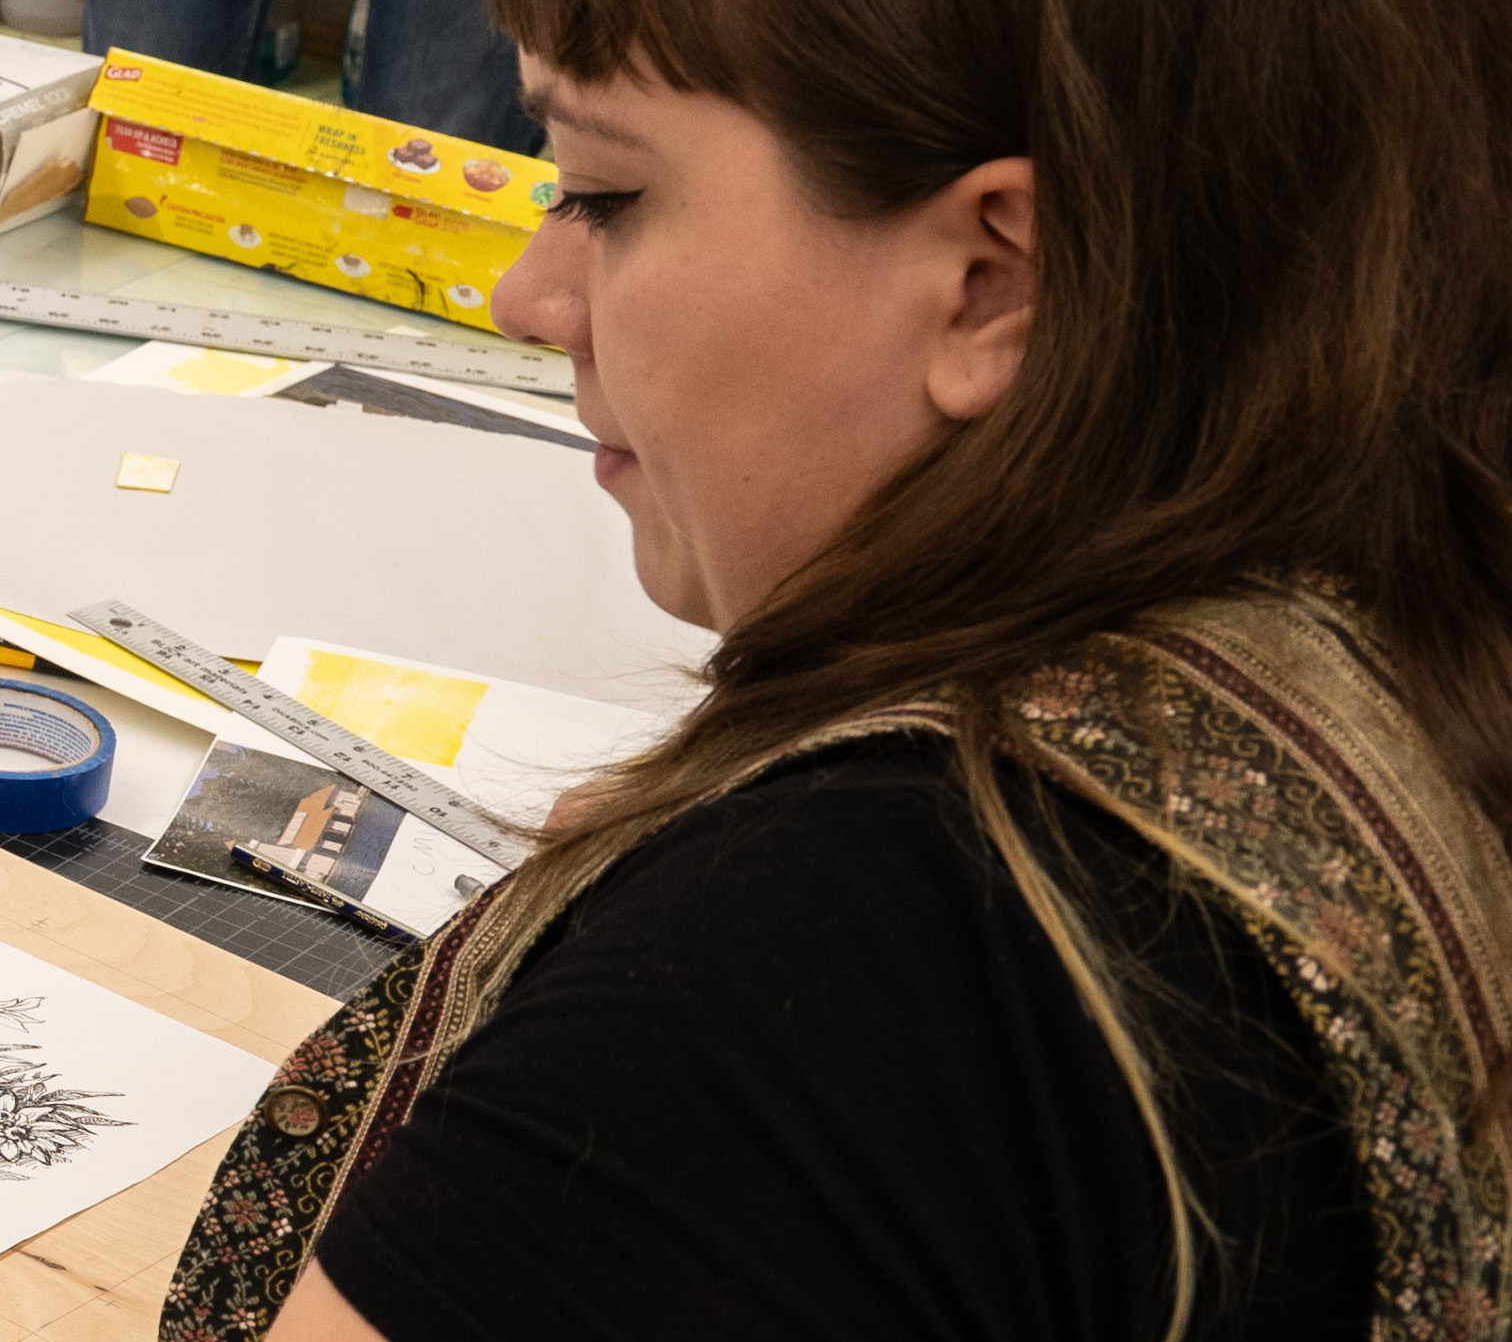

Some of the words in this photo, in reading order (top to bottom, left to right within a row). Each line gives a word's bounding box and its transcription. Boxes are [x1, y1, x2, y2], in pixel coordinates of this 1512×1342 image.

[106, 67, 142, 80] GLAD
[151, 639, 183, 657] BLICK
[183, 658, 201, 667] art
[200, 667, 247, 694] materials
